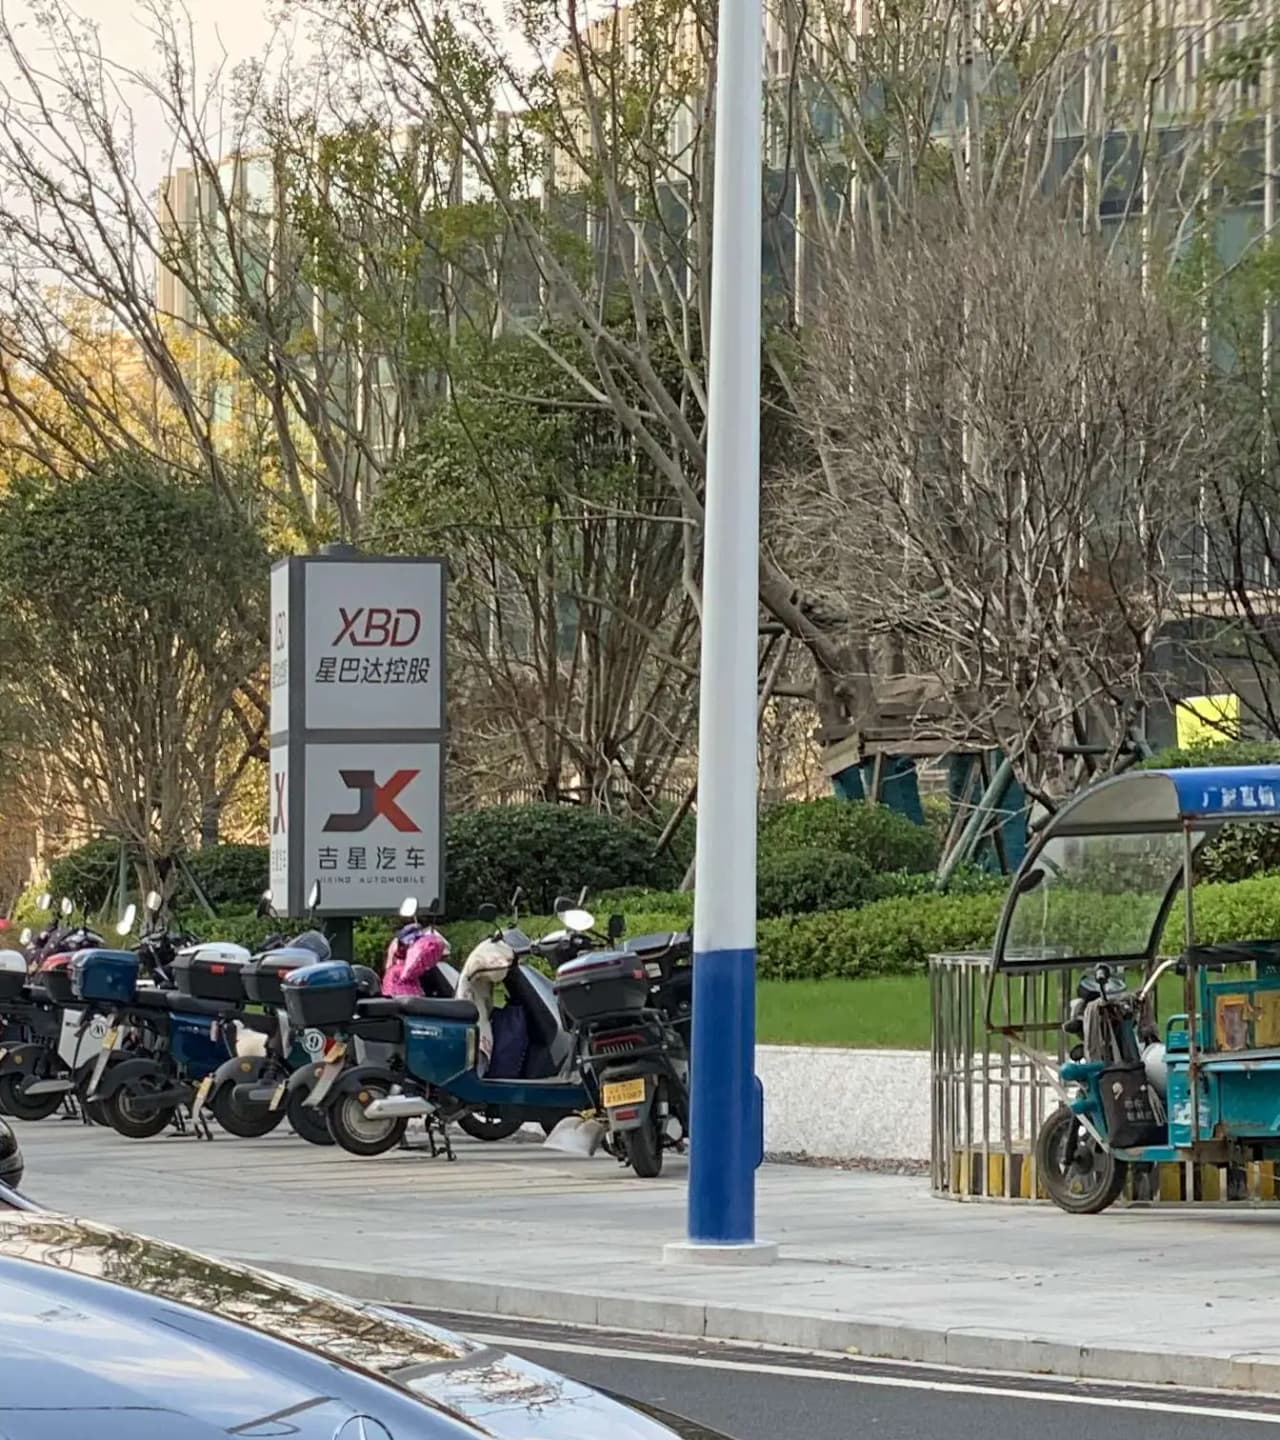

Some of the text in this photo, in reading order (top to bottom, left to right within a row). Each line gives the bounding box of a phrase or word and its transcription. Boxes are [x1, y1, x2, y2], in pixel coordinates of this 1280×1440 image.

[332, 608, 422, 647] XBD
[315, 657, 430, 684] 星巴达控股
[318, 846, 426, 870] 吉星汽车
